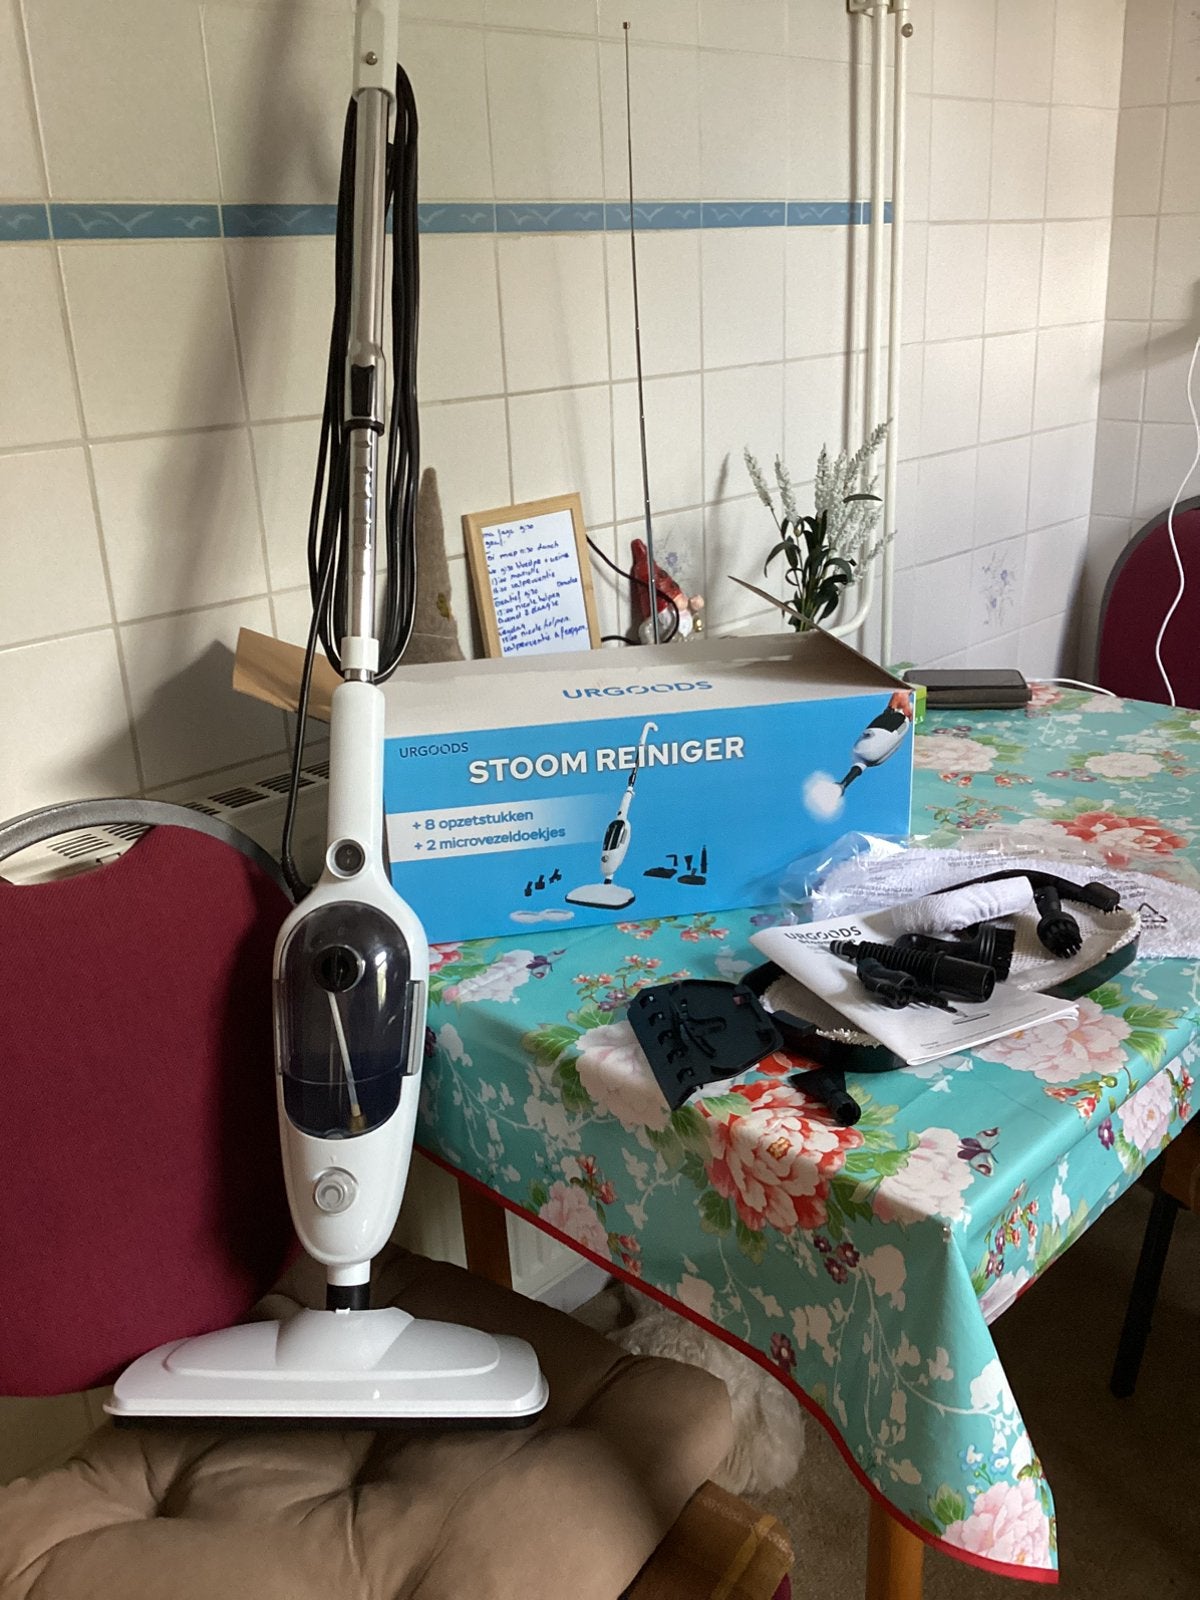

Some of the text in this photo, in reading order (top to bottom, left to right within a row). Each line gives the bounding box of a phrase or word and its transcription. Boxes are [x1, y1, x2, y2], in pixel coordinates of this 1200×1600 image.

[562, 680, 713, 699] URGOODS
[399, 742, 469, 759] URGOODS
[468, 736, 745, 784] STOOM REINIGER
[424, 819, 436, 830] 8
[439, 810, 534, 831] opzetstukken
[426, 839, 437, 850] 2
[439, 827, 566, 850] microvezeldoekjes
[784, 925, 862, 940] URGOODS
